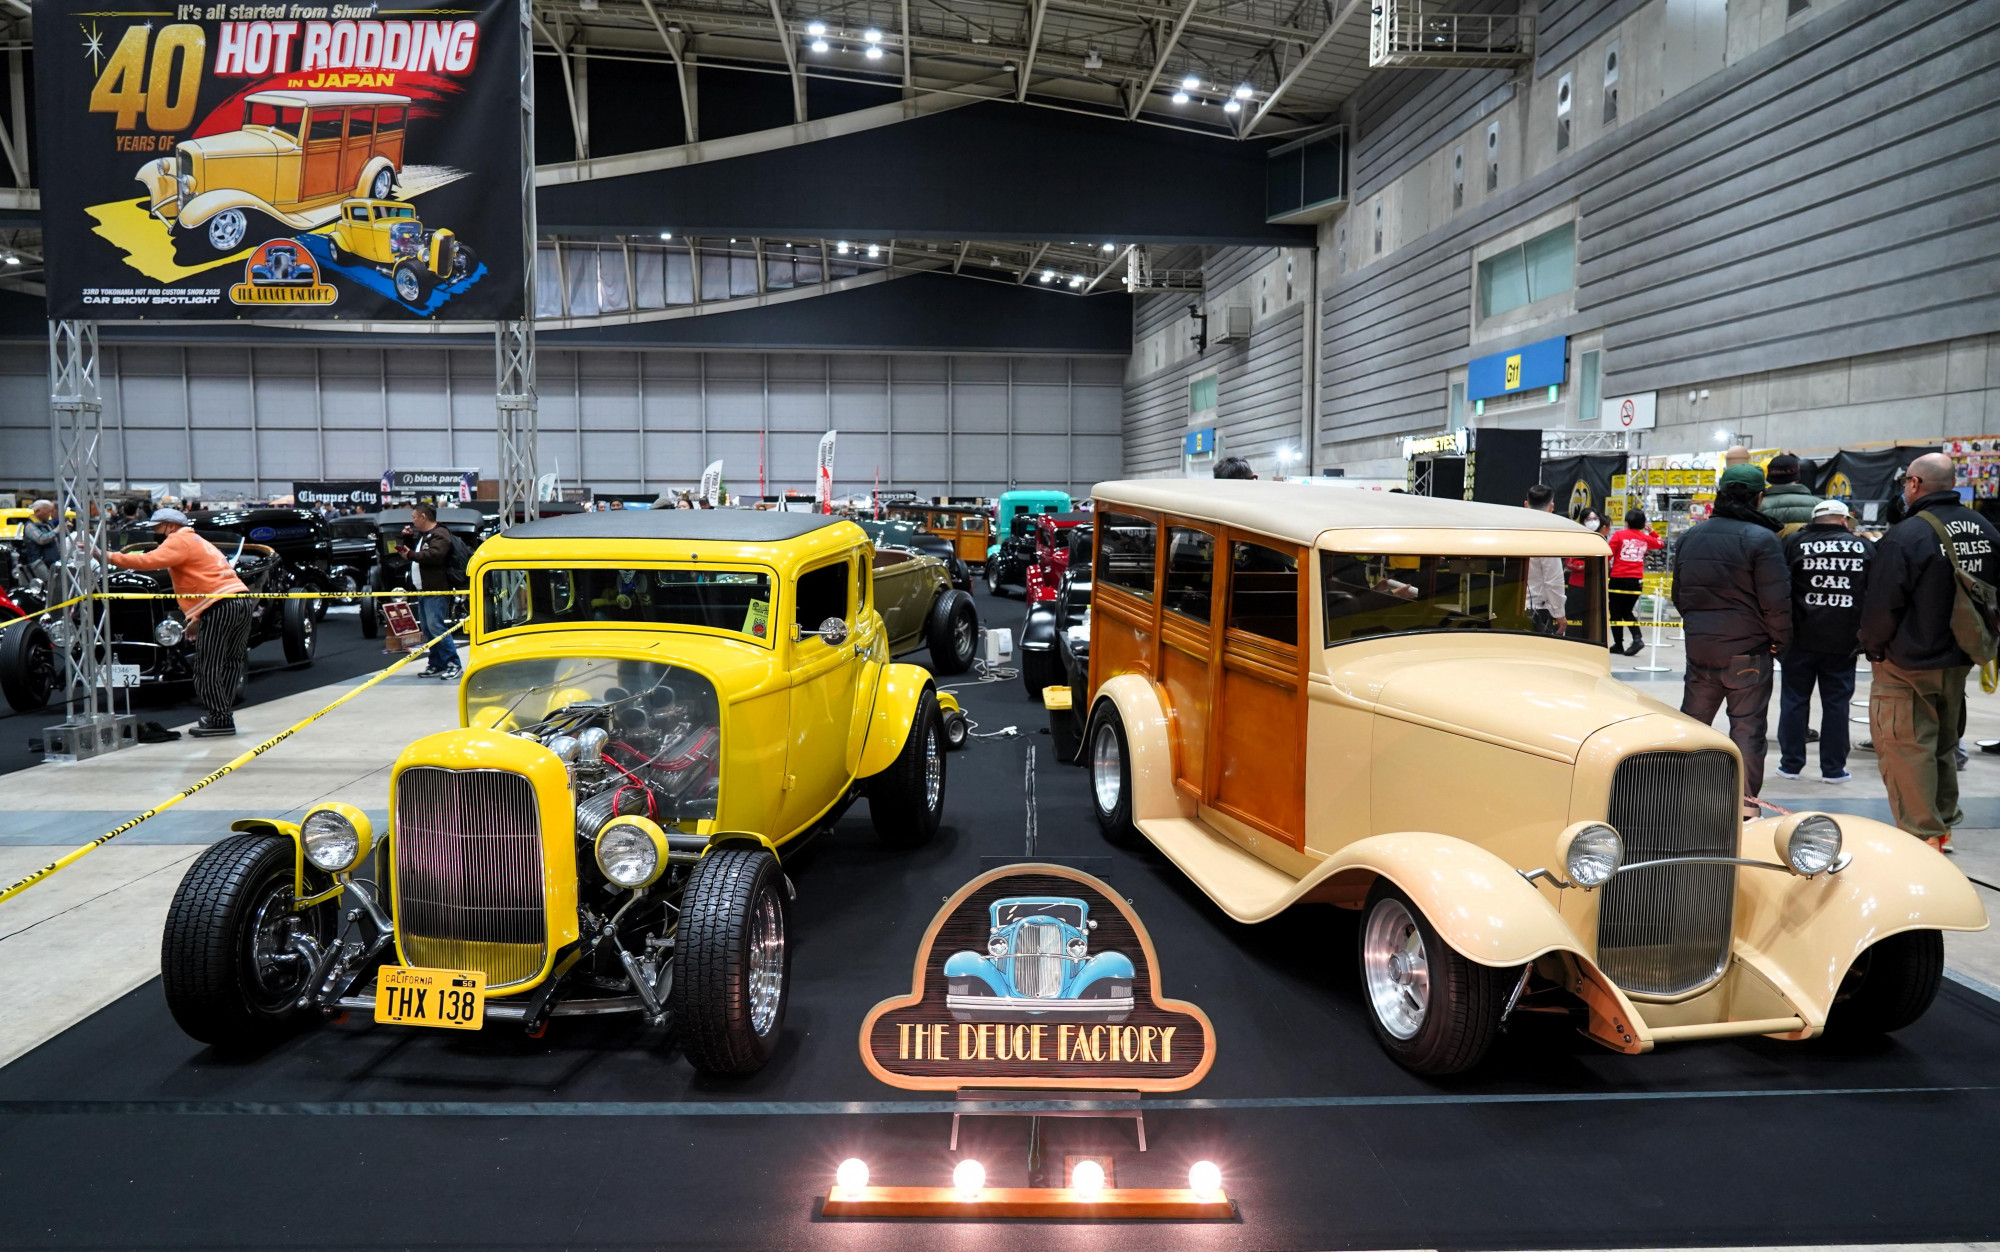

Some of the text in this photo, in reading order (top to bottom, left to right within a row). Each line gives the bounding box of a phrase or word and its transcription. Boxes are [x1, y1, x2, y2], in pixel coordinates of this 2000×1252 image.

[178, 4, 372, 20] It's all started from Shun
[214, 19, 478, 75] HOT RODDING
[89, 23, 206, 132] 40
[288, 73, 395, 88] IN JAPAN
[116, 136, 175, 151] YEARS OF
[238, 288, 254, 300] THE
[257, 288, 286, 300] DEUCE
[1506, 363, 1520, 383] G11
[414, 475, 438, 483] black
[298, 490, 349, 506] Chopper
[350, 490, 377, 504] City
[1800, 540, 1865, 556] TOKYO
[1802, 557, 1864, 572] DRIVE
[1810, 575, 1851, 590] CAR
[1805, 592, 1854, 608] CLUB
[94, 809, 156, 846] CAUTION
[385, 974, 433, 986] CALIFORNIA
[386, 986, 476, 1022] THX 138
[896, 1024, 1177, 1063] THE DEUCE FACTORY
